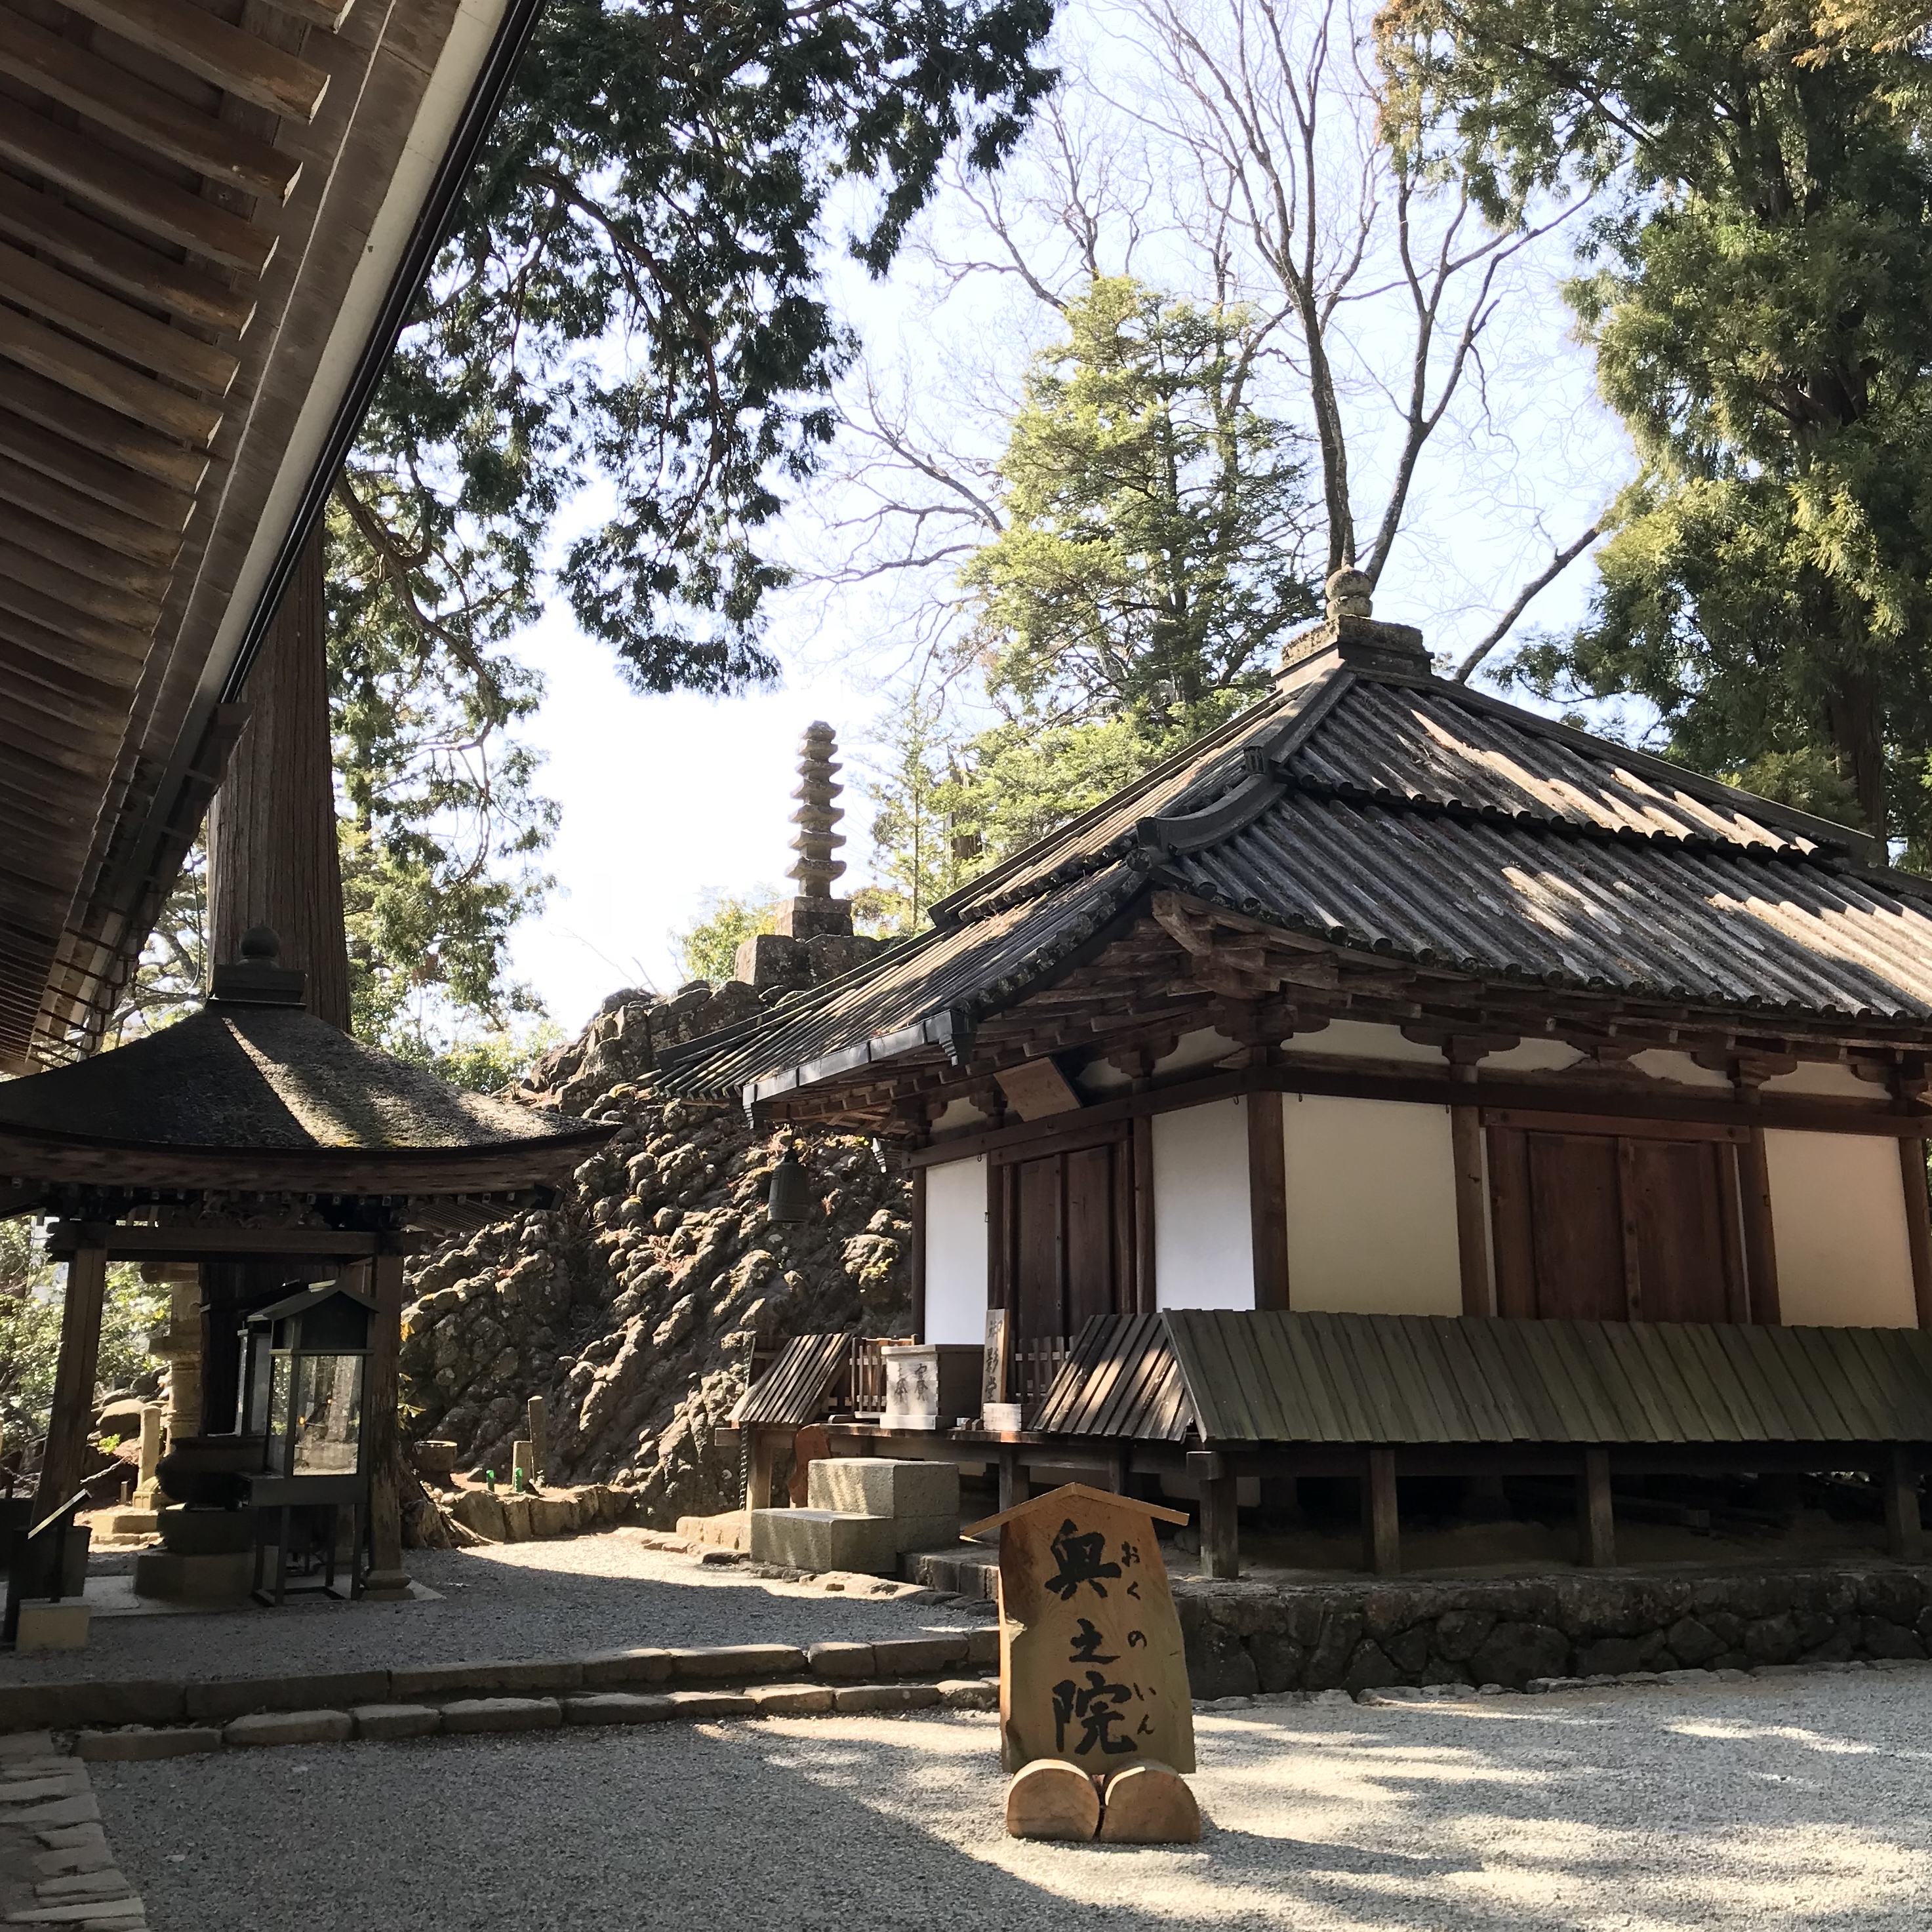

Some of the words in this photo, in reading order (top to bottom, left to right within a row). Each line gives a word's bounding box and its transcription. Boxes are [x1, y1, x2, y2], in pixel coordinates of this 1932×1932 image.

[1045, 1518, 1138, 1755] 奥之院
[1121, 1541, 1156, 1735] おくのいん
